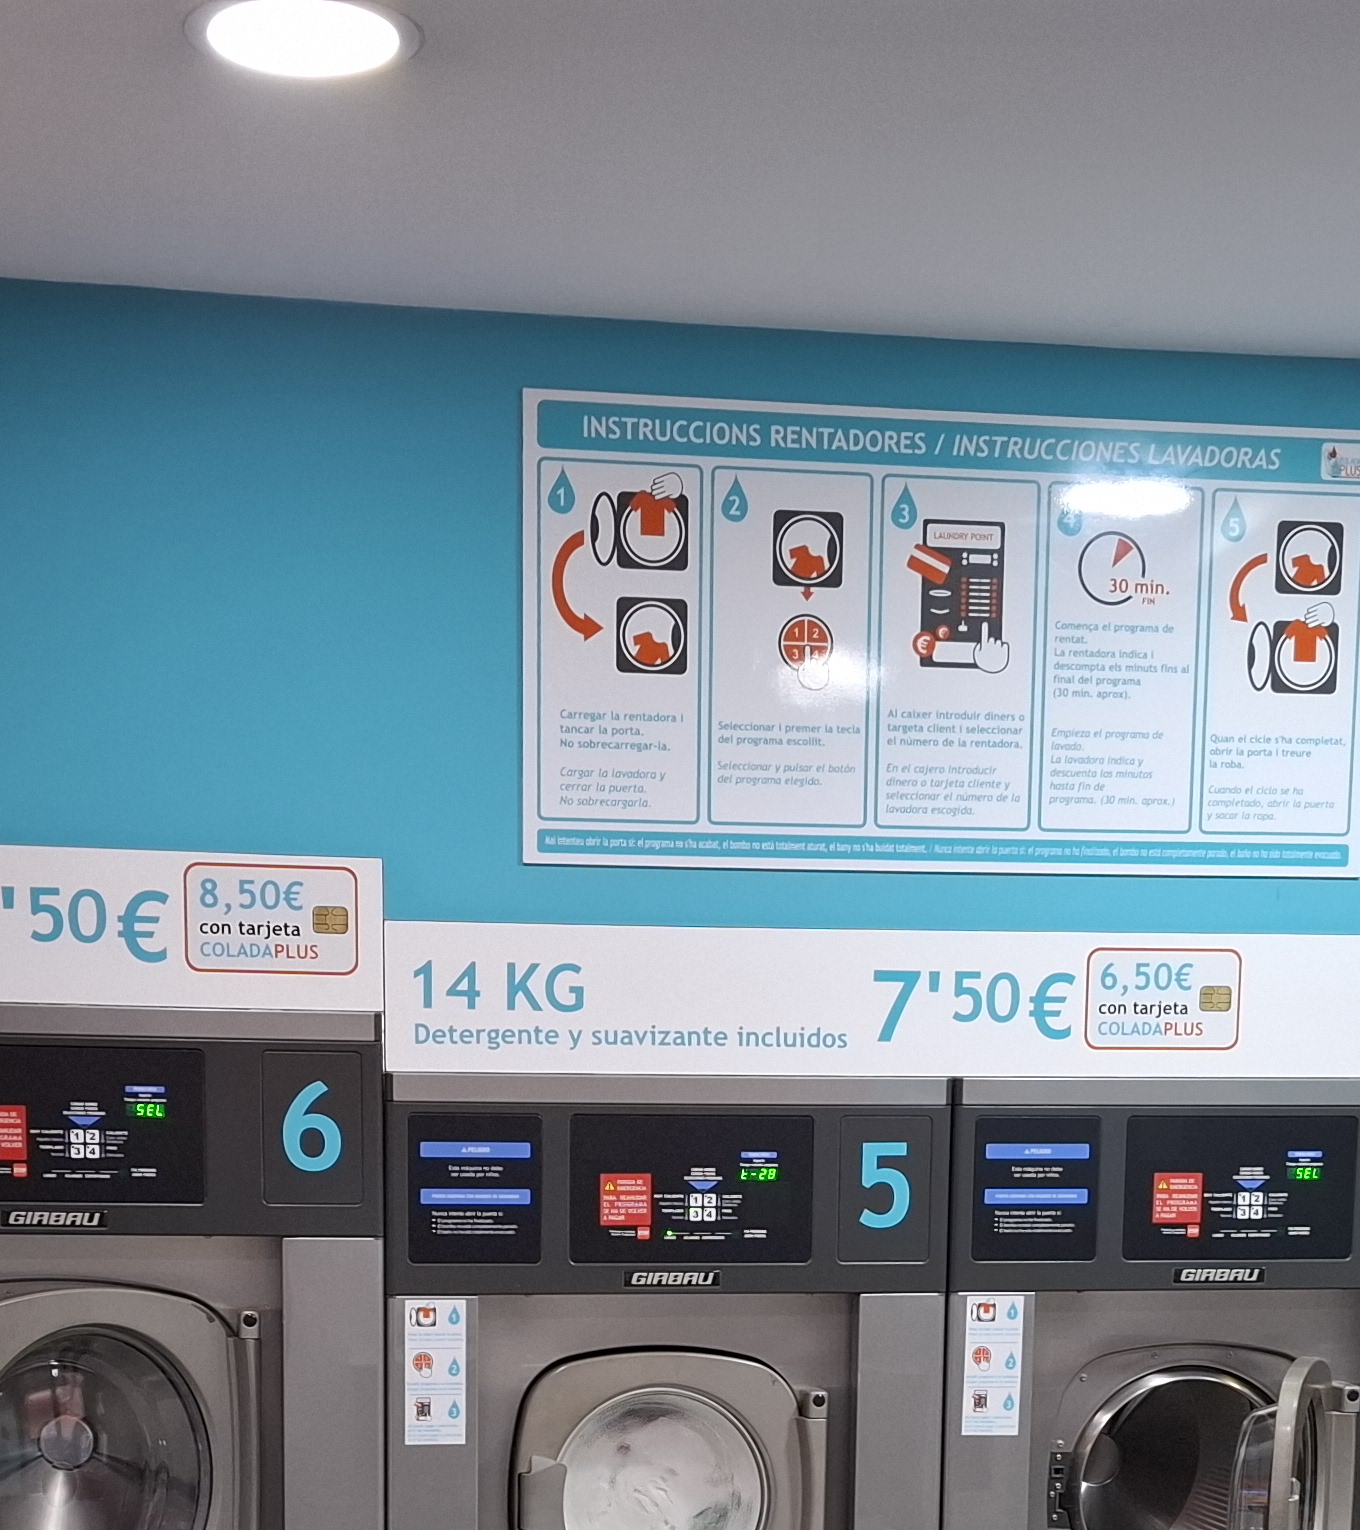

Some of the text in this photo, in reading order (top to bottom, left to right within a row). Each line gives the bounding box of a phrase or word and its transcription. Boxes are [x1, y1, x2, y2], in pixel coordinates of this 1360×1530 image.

[583, 415, 1281, 470] INSTRUCCIONS RENTADORES / INSTRUCCIONES LAVADORAS
[557, 488, 566, 506] 1
[729, 495, 740, 515] 2
[899, 504, 910, 523] 3
[1228, 518, 1239, 537] 5
[1109, 578, 1170, 595] 30 min.
[559, 708, 606, 722] Carregar
[623, 712, 676, 722] rentadora
[900, 709, 932, 719] caixer
[935, 710, 980, 720] introduir
[984, 711, 1014, 721] diners
[559, 724, 594, 734] tancar
[611, 726, 643, 736] porta.
[887, 723, 923, 734] targeta
[926, 723, 955, 733] client
[965, 724, 1022, 734] seleccionar
[577, 738, 670, 752] sobrecarregar-la.
[899, 738, 938, 746] número
[970, 738, 1022, 748] rentadora.
[199, 878, 303, 914] 8,50€
[199, 920, 300, 939] con tarjeta
[200, 941, 318, 959] COLADAPLUS
[413, 959, 584, 1012] 14 KG
[1100, 962, 1193, 995] 6,50€
[1098, 1000, 1187, 1018] con tarjeta
[414, 1023, 847, 1050] Detergente y suavizante incluidos
[1098, 1021, 1203, 1036] COLADAPLUS
[282, 1080, 341, 1171] 6
[859, 1142, 909, 1228] 5
[8, 1211, 100, 1225] GIRBAU
[631, 1272, 714, 1285] GIRBAU
[1180, 1268, 1260, 1281] GIRBAU
